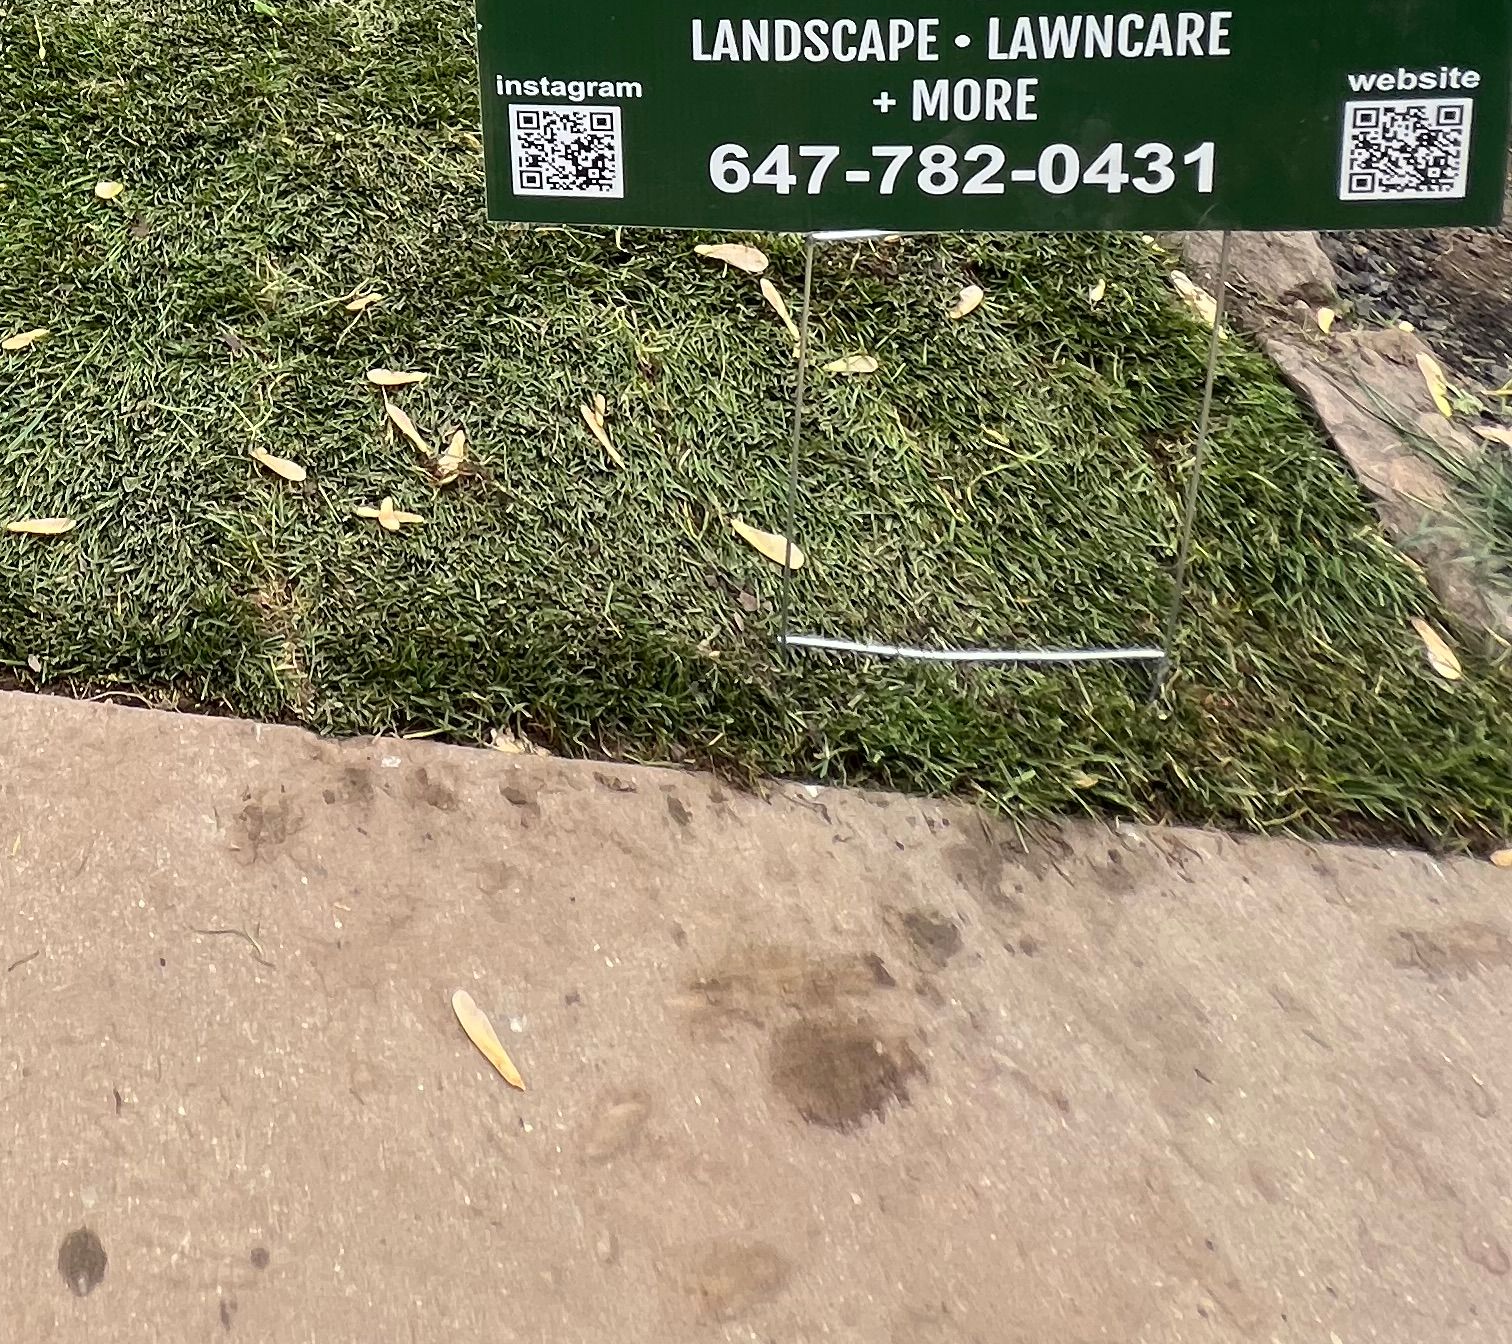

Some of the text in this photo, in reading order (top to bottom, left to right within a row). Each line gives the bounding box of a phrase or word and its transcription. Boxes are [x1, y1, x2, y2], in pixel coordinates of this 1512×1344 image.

[692, 18, 940, 62] LANDSCAPE
[988, 11, 1233, 60] LAWNCARE
[496, 75, 643, 102] instagram
[912, 77, 1039, 122] MORE
[1348, 67, 1481, 92] website
[709, 141, 1216, 196] 647-782-0431
